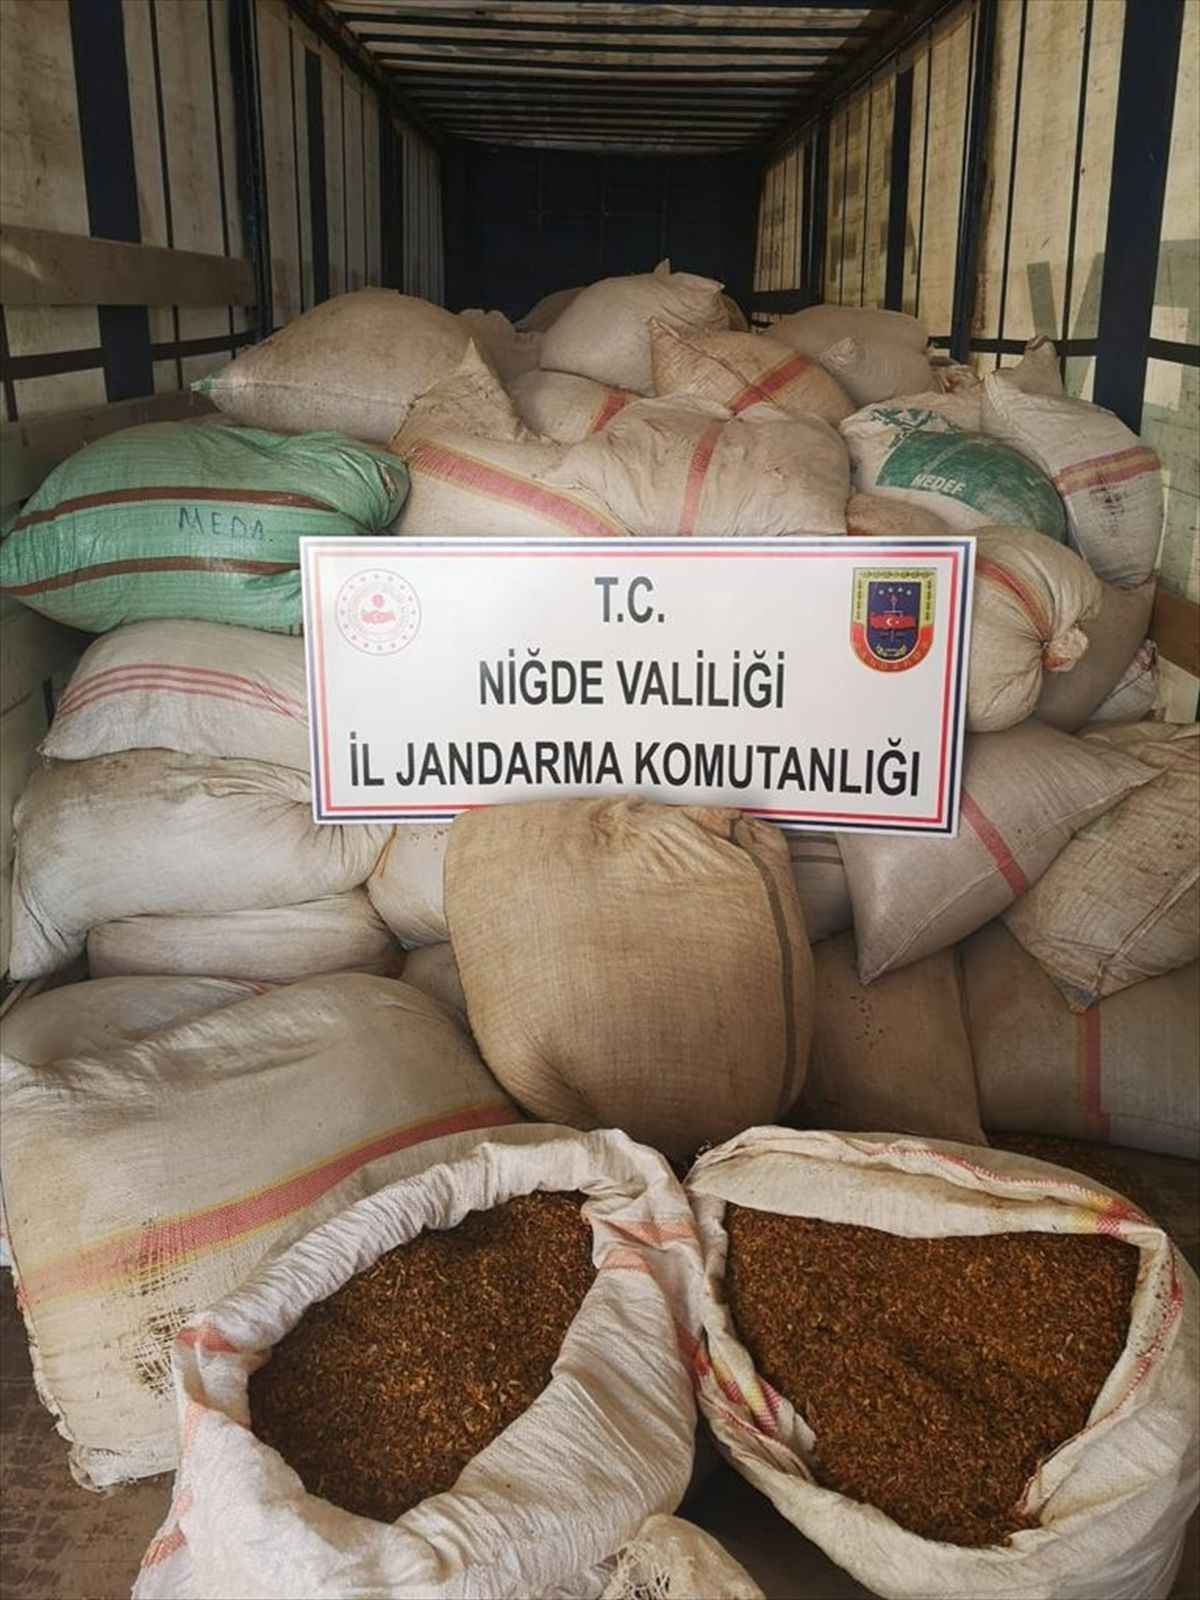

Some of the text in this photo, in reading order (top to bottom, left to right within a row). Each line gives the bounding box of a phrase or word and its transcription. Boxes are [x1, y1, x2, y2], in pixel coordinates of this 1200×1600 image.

[594, 575, 666, 624] T.C.
[479, 647, 785, 709] NİĞDE VALİLİĞİ
[349, 731, 921, 797] İL JANDARMA KOMUTANLIĞI
